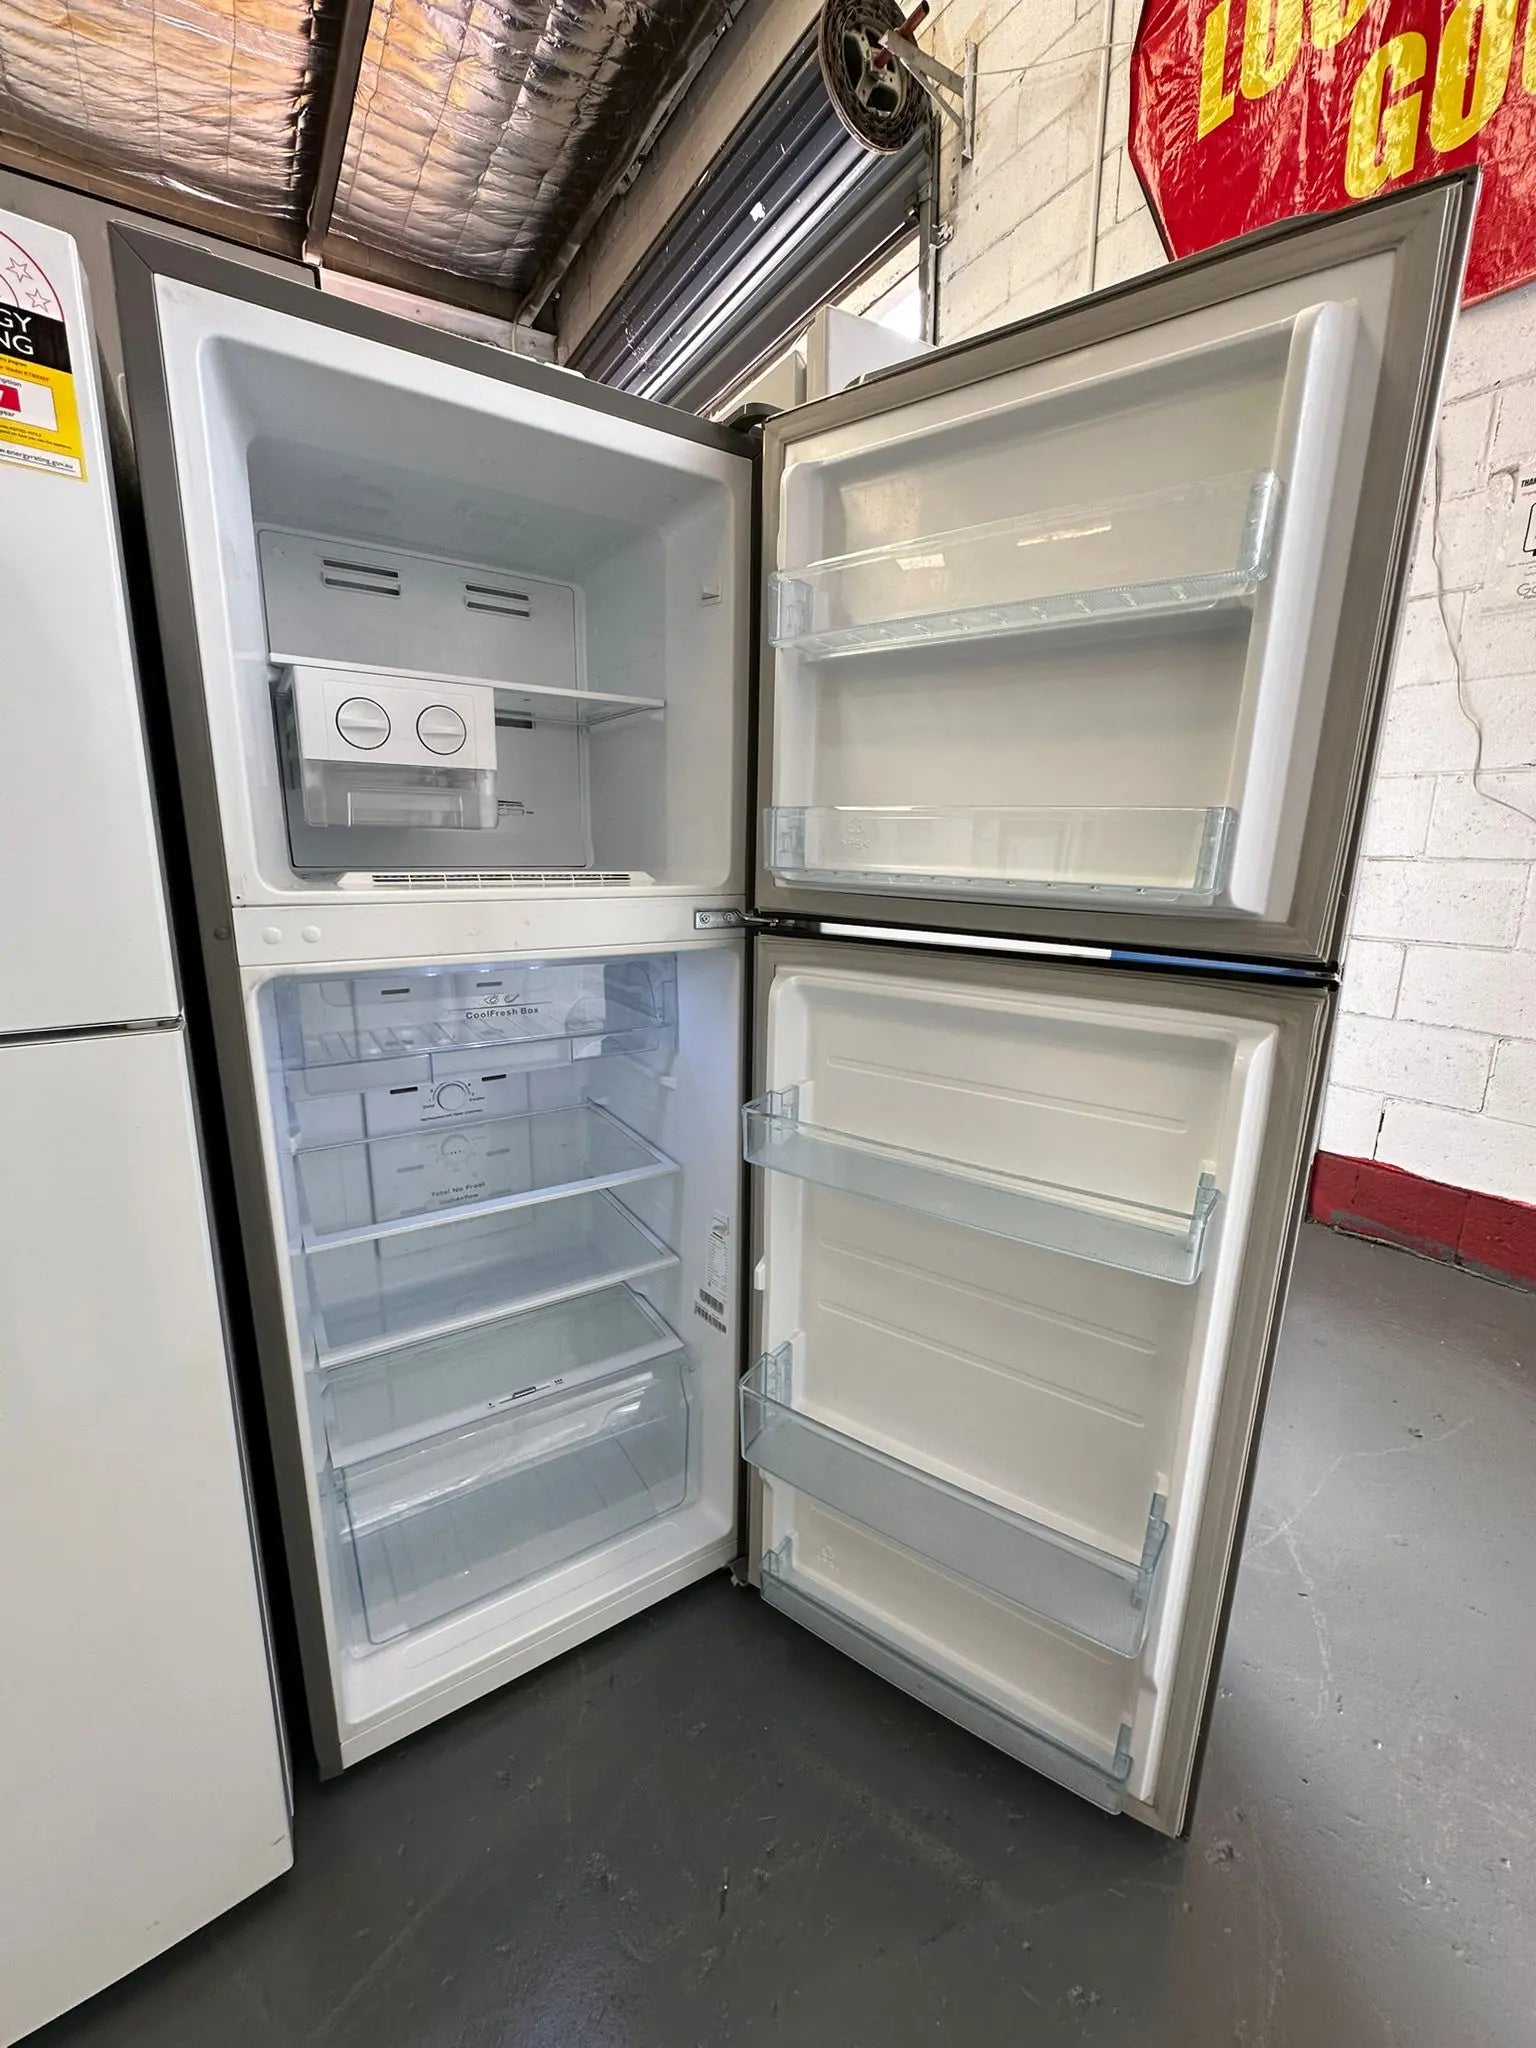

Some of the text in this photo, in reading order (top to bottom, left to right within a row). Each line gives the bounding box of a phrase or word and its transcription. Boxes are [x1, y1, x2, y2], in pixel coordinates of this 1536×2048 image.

[465, 1007, 540, 1019] CoolFresh Box
[431, 1188, 450, 1197] Total
[466, 1181, 486, 1190] Frost
